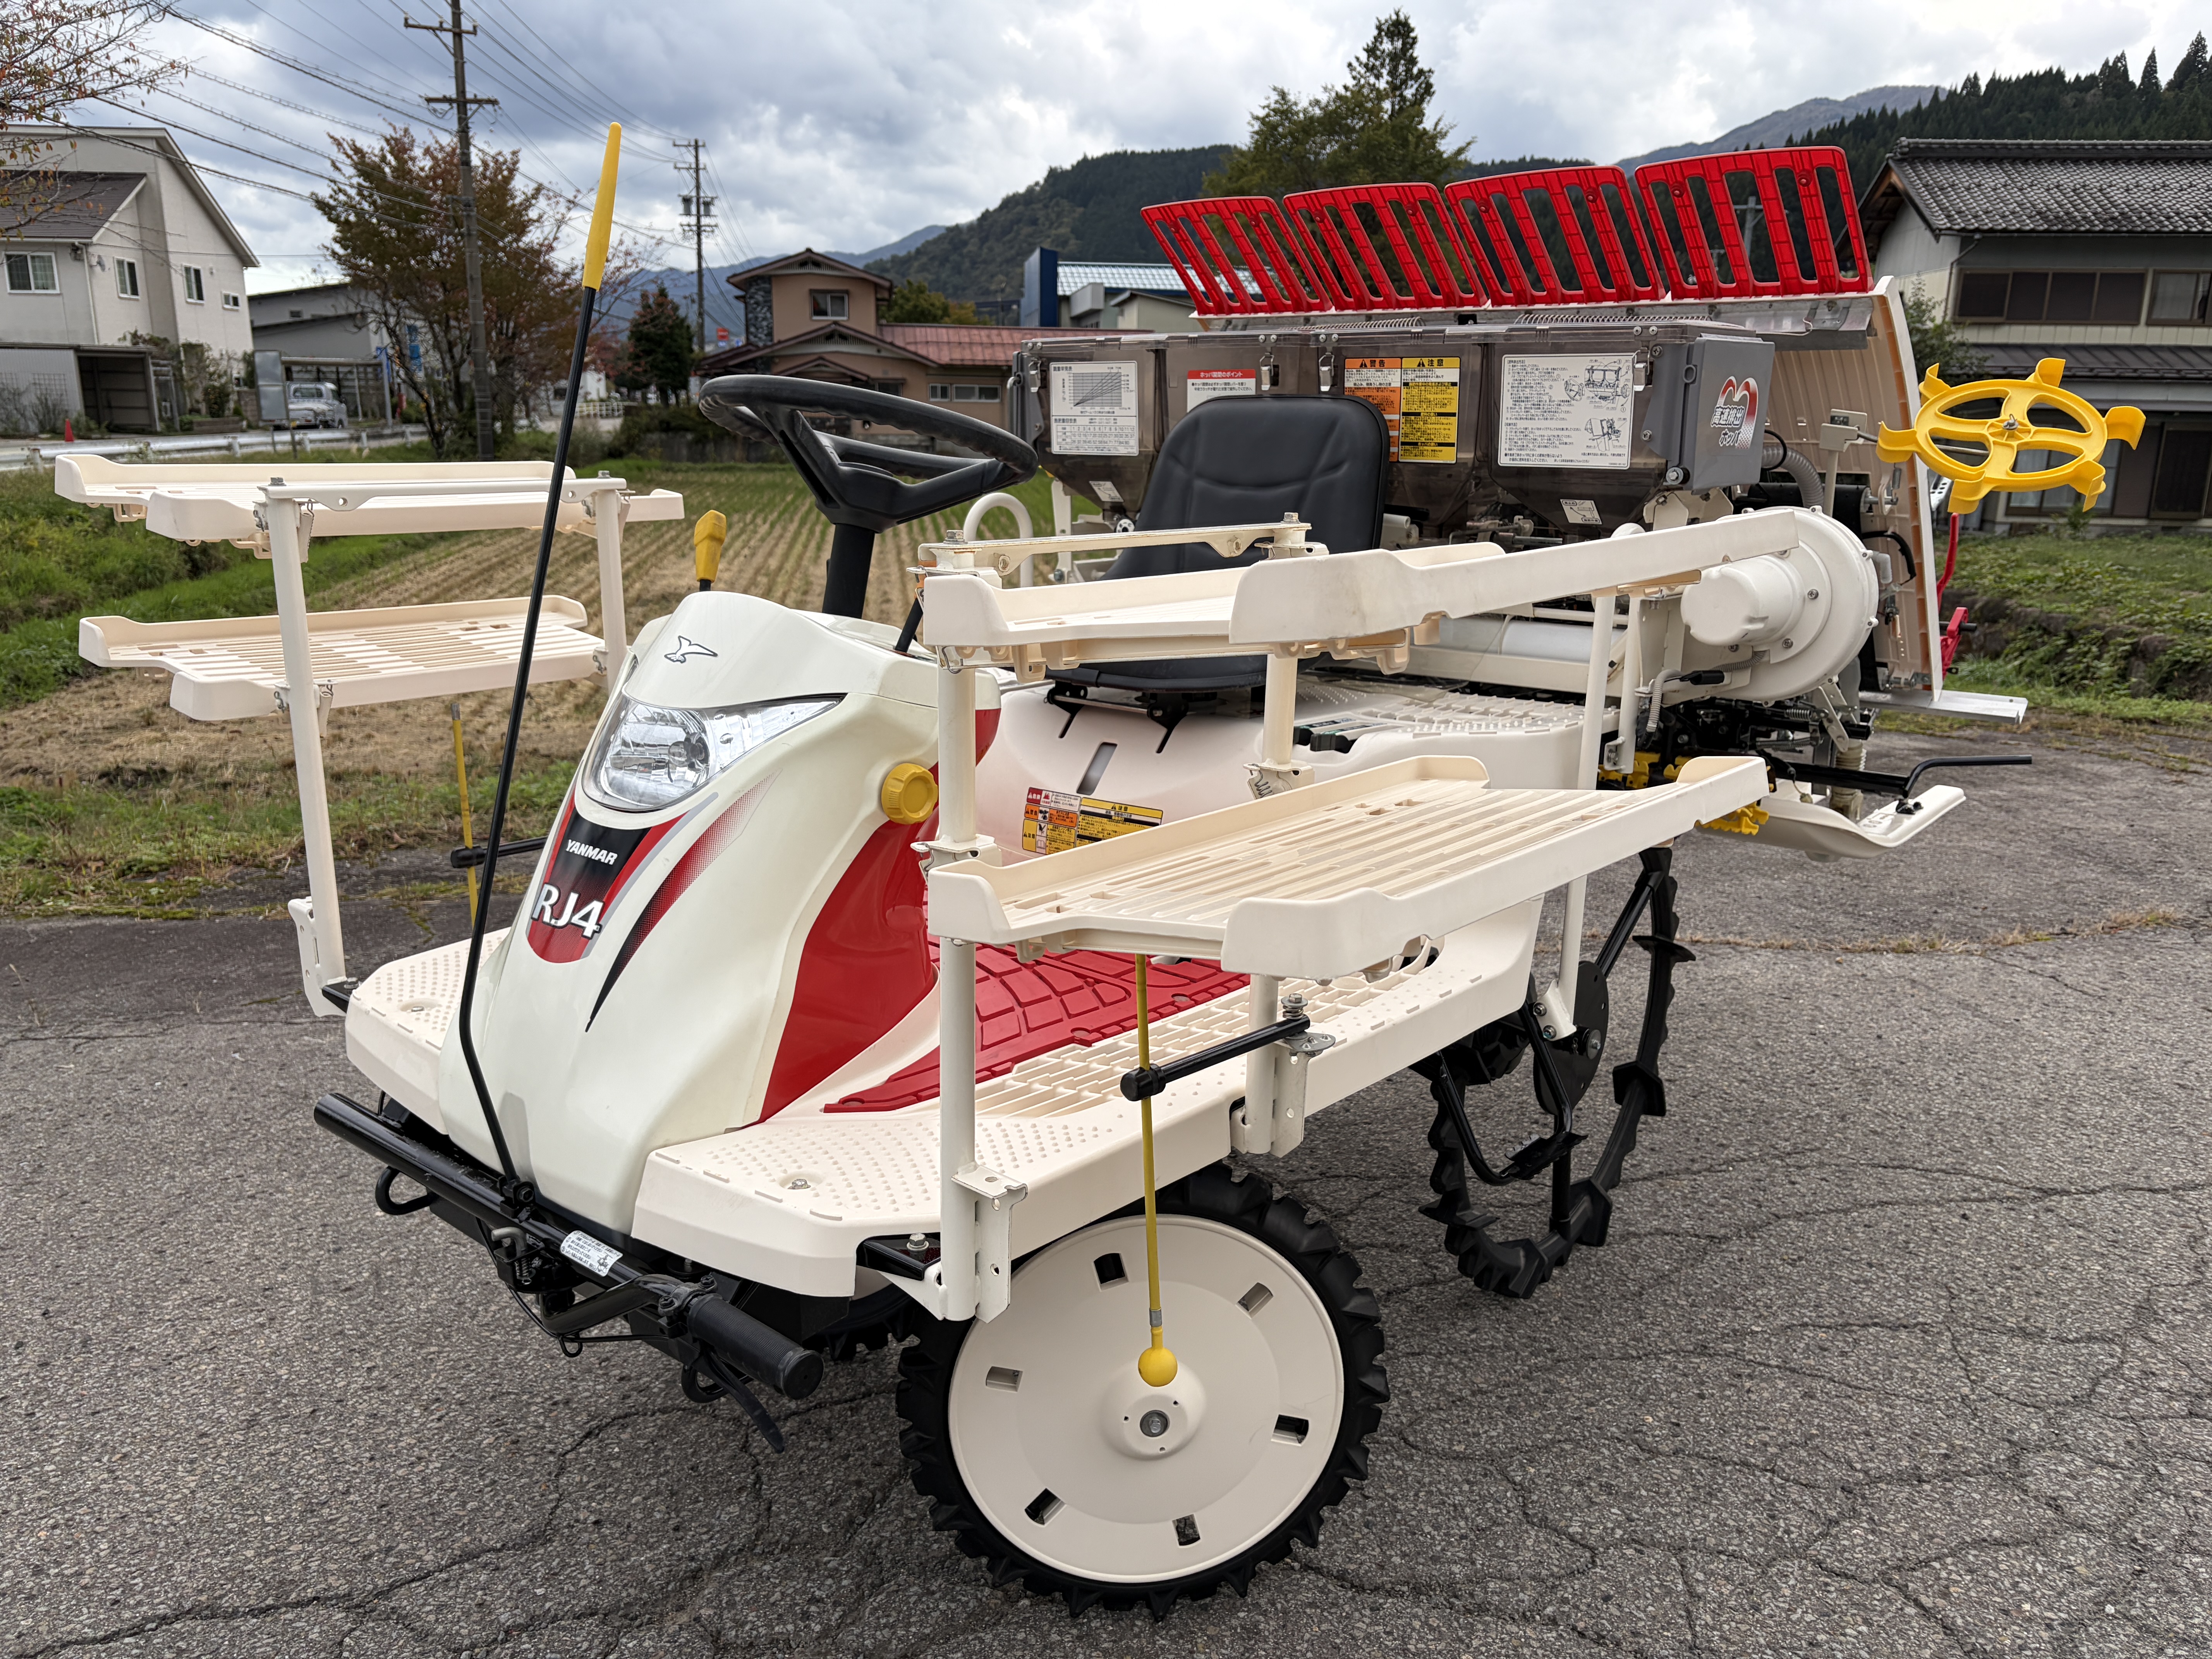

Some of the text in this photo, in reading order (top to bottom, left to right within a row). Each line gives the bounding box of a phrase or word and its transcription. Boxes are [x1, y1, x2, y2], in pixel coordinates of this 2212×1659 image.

[1427, 359, 1444, 367] 注意
[1711, 405, 1745, 428] 高速排出
[1719, 429, 1742, 446] ホッパ
[566, 839, 618, 865] YANMAR
[531, 883, 604, 939] RJ4
